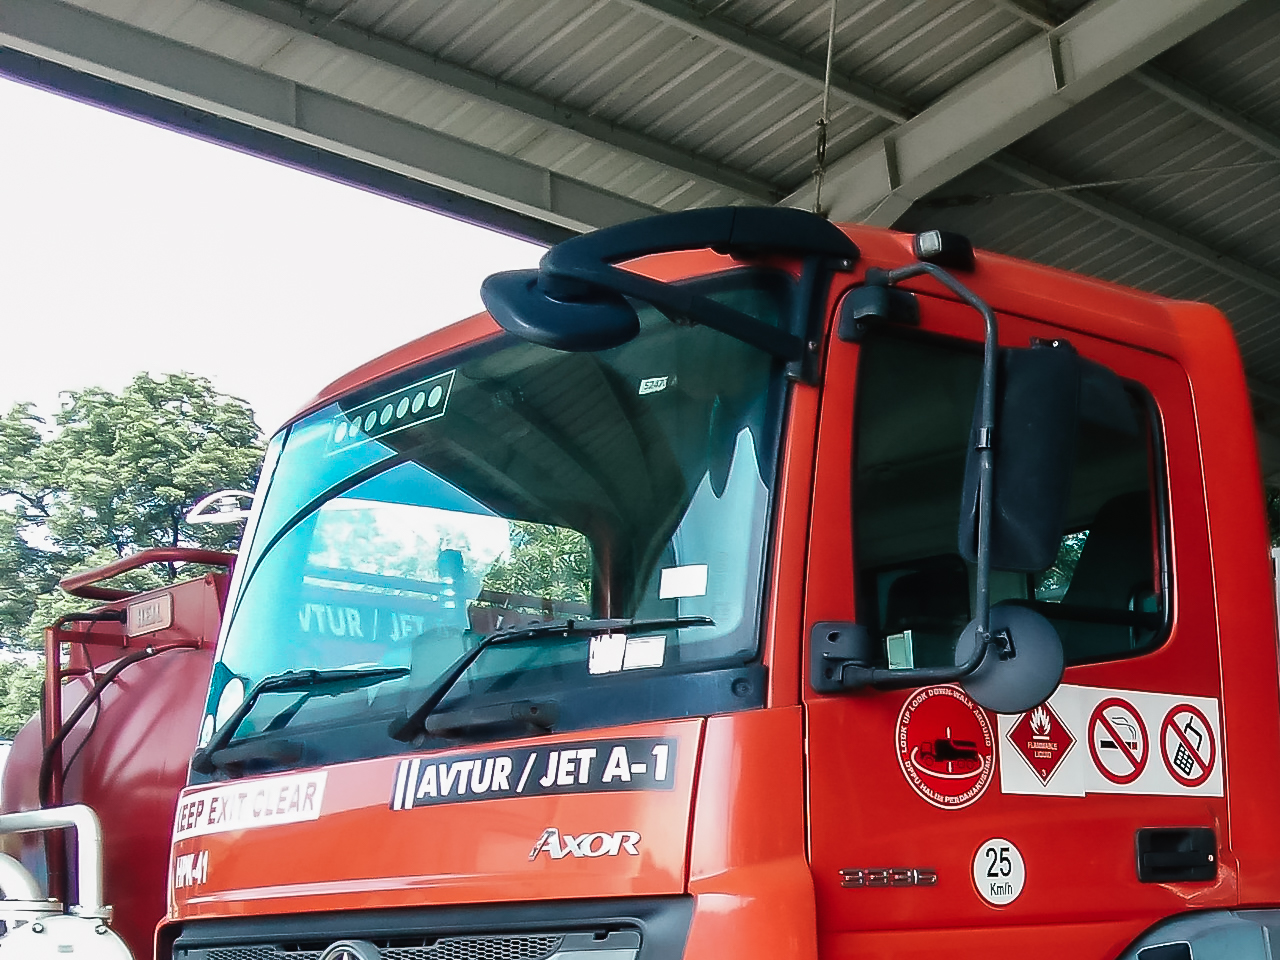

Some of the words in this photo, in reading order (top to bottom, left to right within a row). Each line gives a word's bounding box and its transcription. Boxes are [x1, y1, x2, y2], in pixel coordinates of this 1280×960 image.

[417, 755, 512, 799] AVTUR
[516, 752, 537, 793] /
[539, 748, 597, 788] JET
[602, 744, 669, 783] A-1
[207, 797, 248, 825] EXIT
[253, 782, 317, 818] CLEAR
[175, 850, 209, 889] HPK-41
[985, 847, 1012, 877] 25
